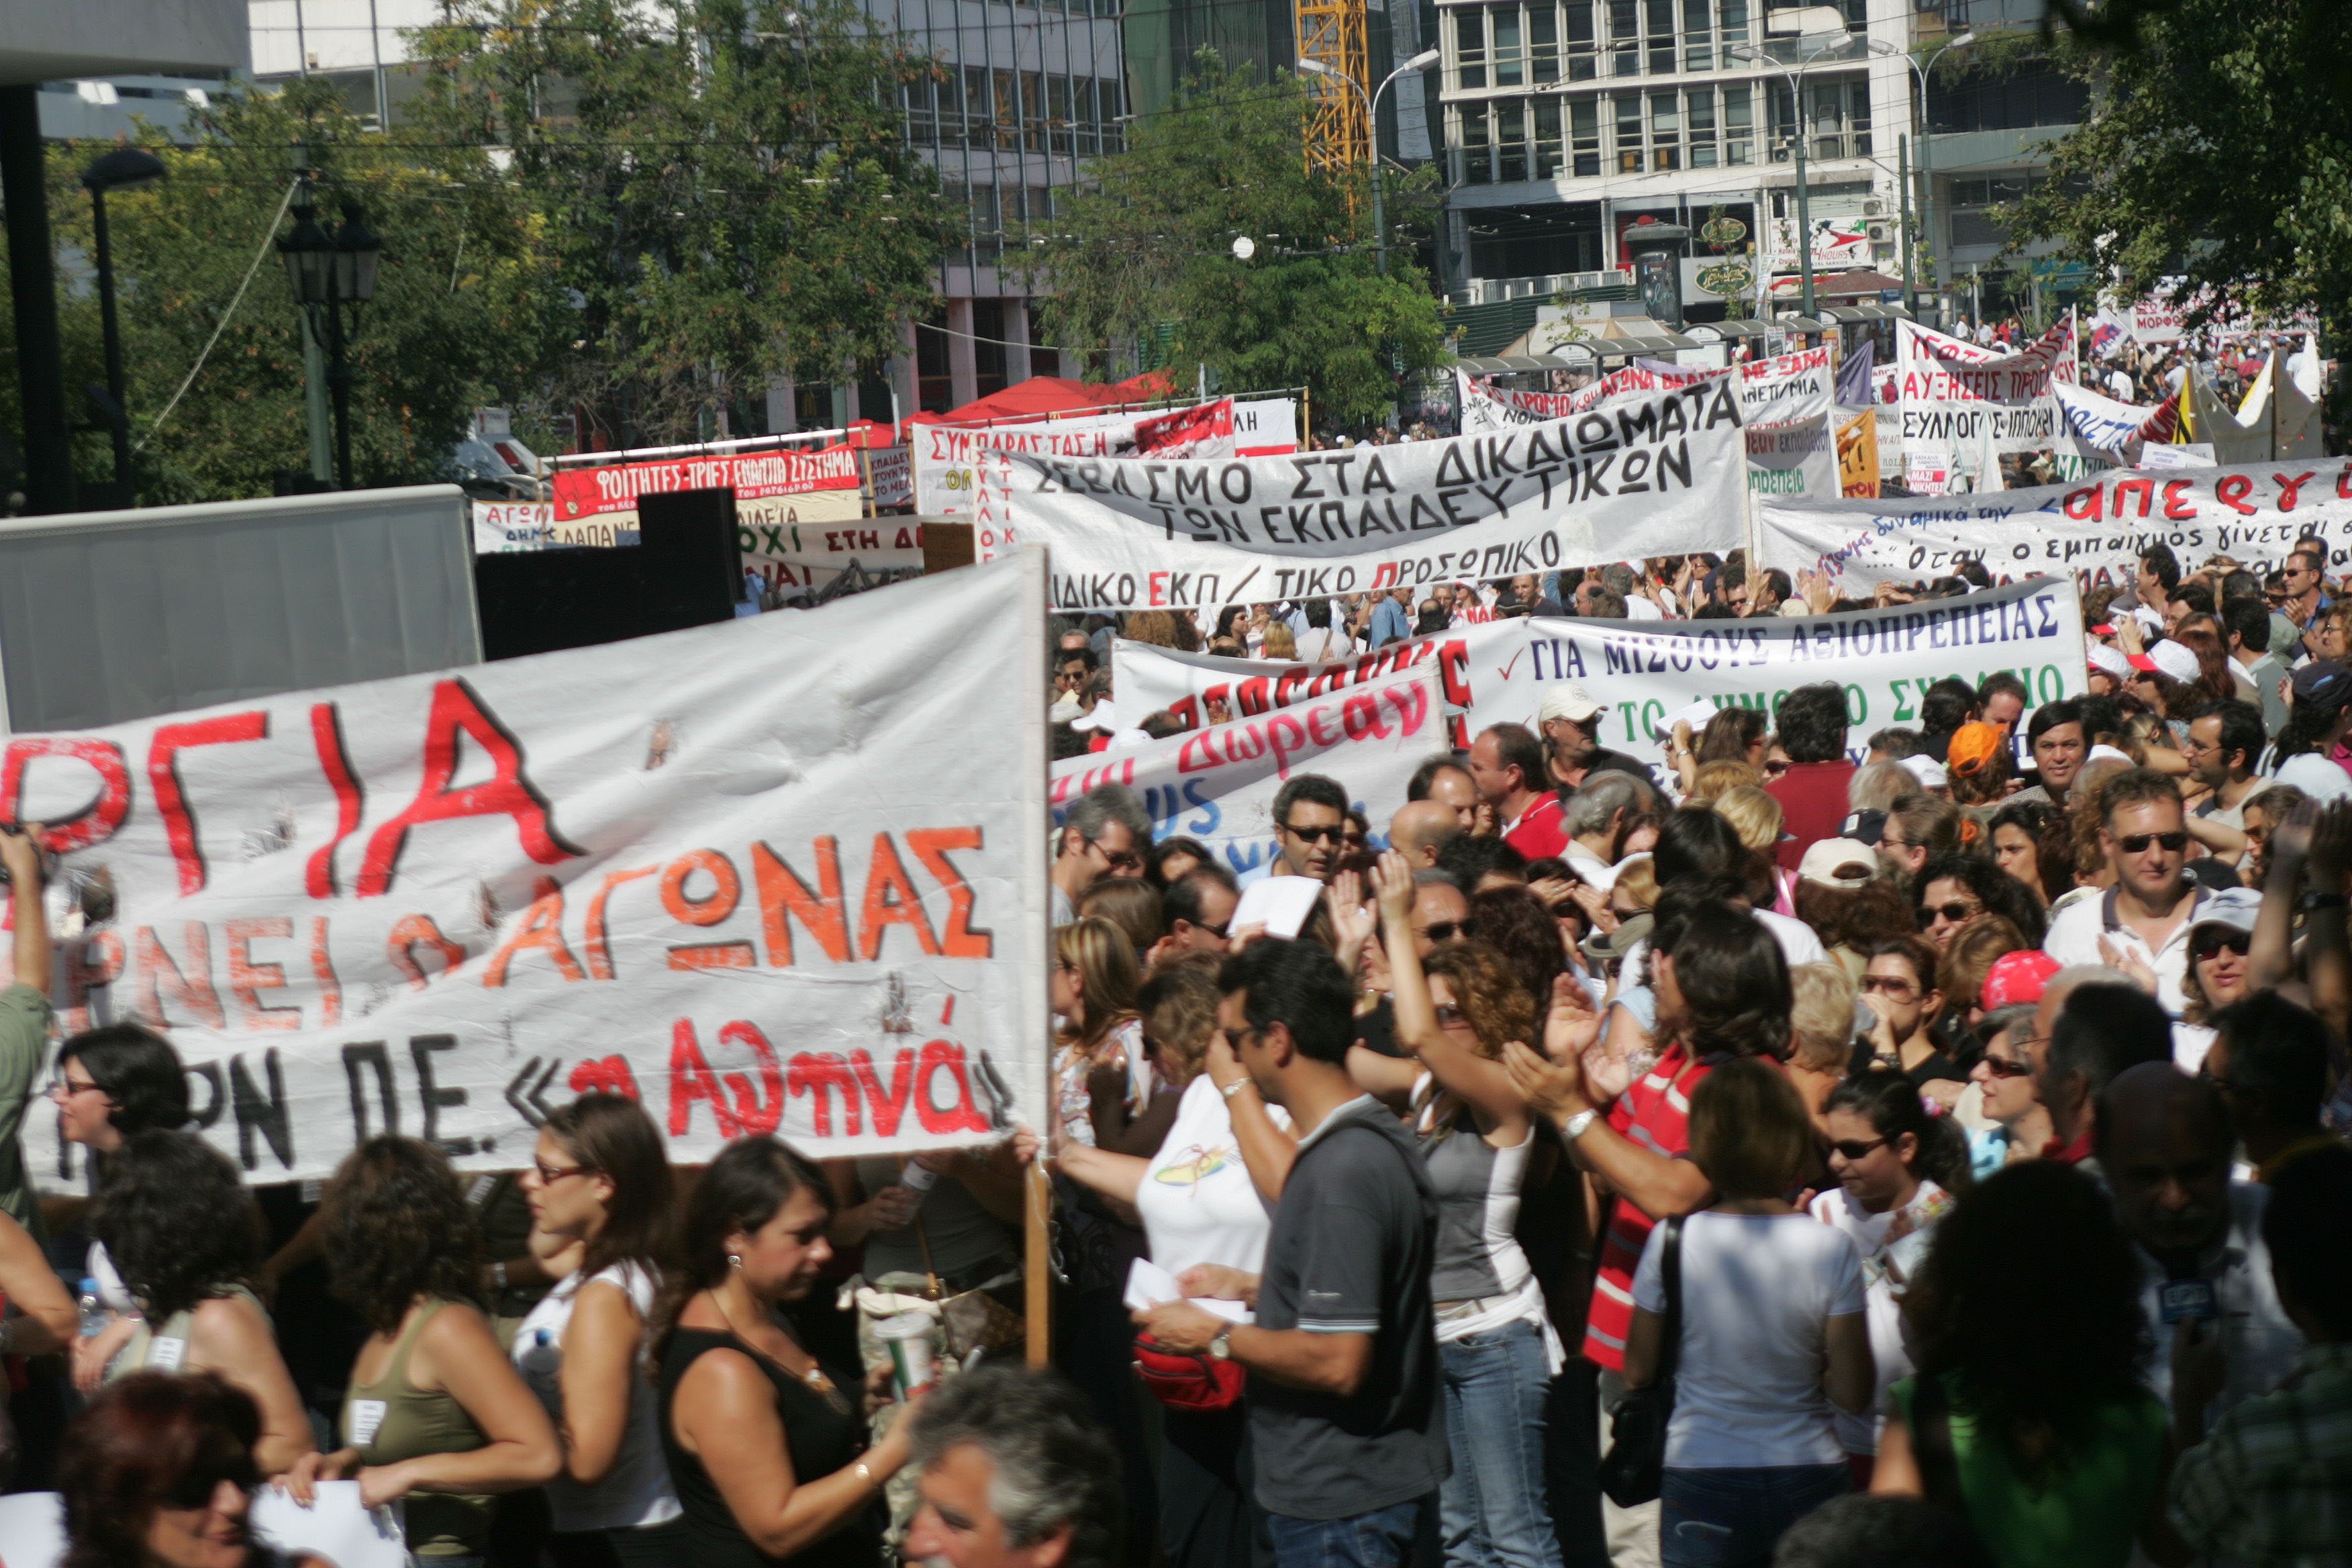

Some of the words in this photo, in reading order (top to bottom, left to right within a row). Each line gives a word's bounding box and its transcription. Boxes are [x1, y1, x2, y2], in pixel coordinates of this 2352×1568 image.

[1512, 391, 1571, 418] ΔΡΟΜΟ
[1600, 369, 1655, 397] ΑΓΩΝΑ
[1775, 348, 1830, 376] ΞΑΝΑ
[1904, 371, 2002, 400] ΑΥΞΗΣΕΙΣ
[1291, 452, 1398, 500] ΣΤΑ
[1434, 378, 1743, 489] ΔΙΚΑΙΩΜΑΤΑ
[1911, 471, 1933, 481] ΜΑΖΙ
[824, 529, 880, 552] ΣΤΗ
[1148, 503, 1252, 543] ΤΩΝ
[1872, 506, 1968, 537] δυναμικά
[1977, 505, 2014, 523] την
[2217, 518, 2329, 551] γίνεται
[1370, 530, 1560, 590] ΠΡΟΣΩΠΙΚΟ
[1530, 638, 1586, 681] ΓΙΑ
[1604, 626, 1770, 673] ΜΙΣΘΟΥΣ
[1790, 593, 2059, 663] ΑΞΙΟΠΡΕΠΕΙΑΣ
[1178, 681, 1428, 781] Δωρεάν
[1618, 697, 1665, 742] ΤΟ
[483, 826, 994, 988] ΑΓΩΝΑΣ
